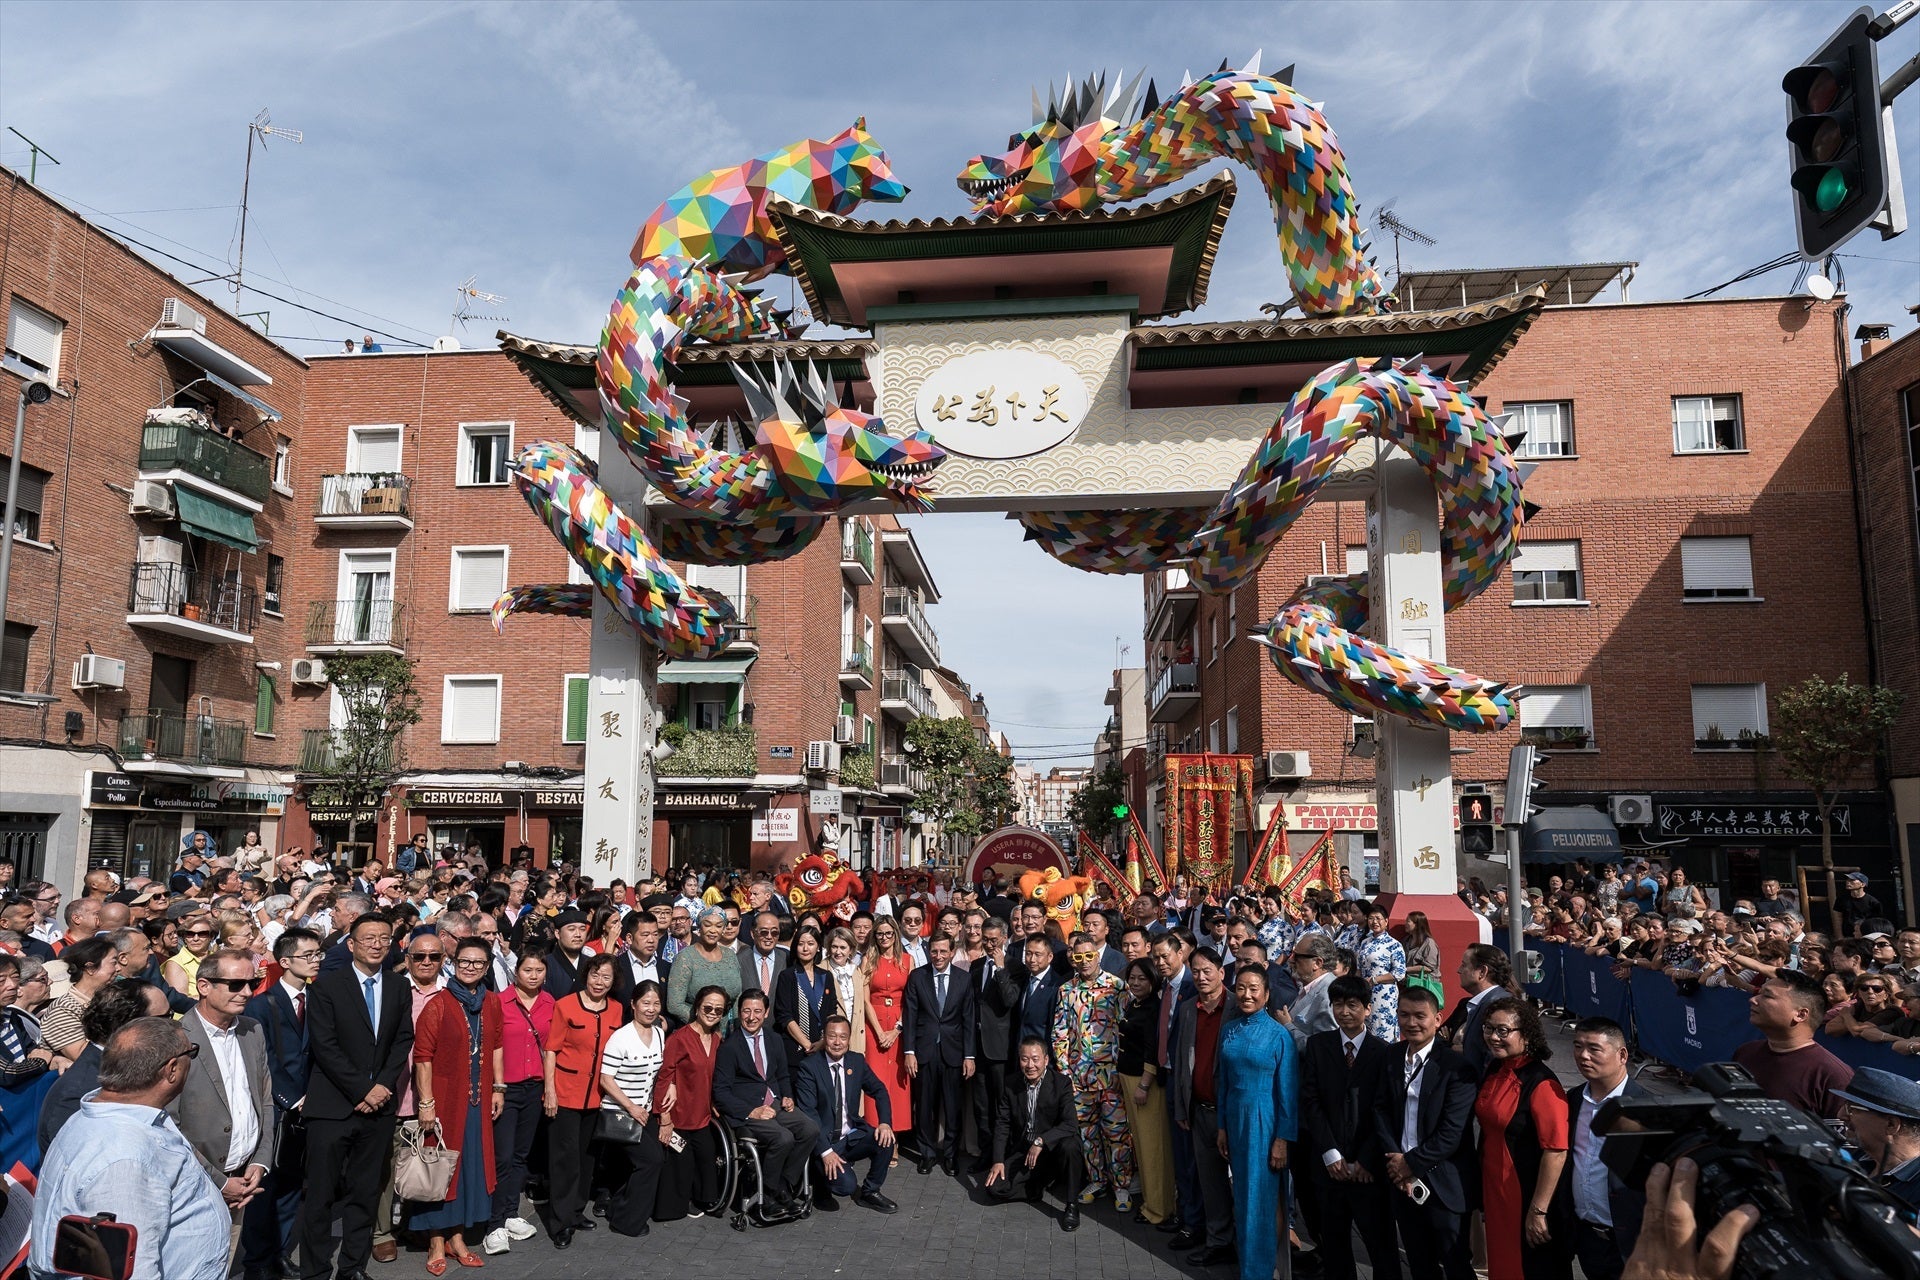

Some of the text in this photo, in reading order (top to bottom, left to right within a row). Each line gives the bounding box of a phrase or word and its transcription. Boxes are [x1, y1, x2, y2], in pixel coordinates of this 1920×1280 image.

[107, 776, 130, 786] Carnes
[107, 793, 126, 802] Pollo
[423, 792, 503, 804] CERVECERIA
[665, 793, 738, 806] BARRANCO
[153, 798, 192, 809] Especialistas
[200, 800, 217, 809] Carne
[761, 822, 789, 830] CAETERÍA
[1301, 817, 1378, 829] FRUTO
[1703, 827, 1813, 835] PELUQUERIA
[1551, 833, 1614, 847] PELUQUERIA
[991, 839, 1015, 854] USERA
[1003, 852, 1016, 860] UC
[1022, 852, 1033, 860] ES
